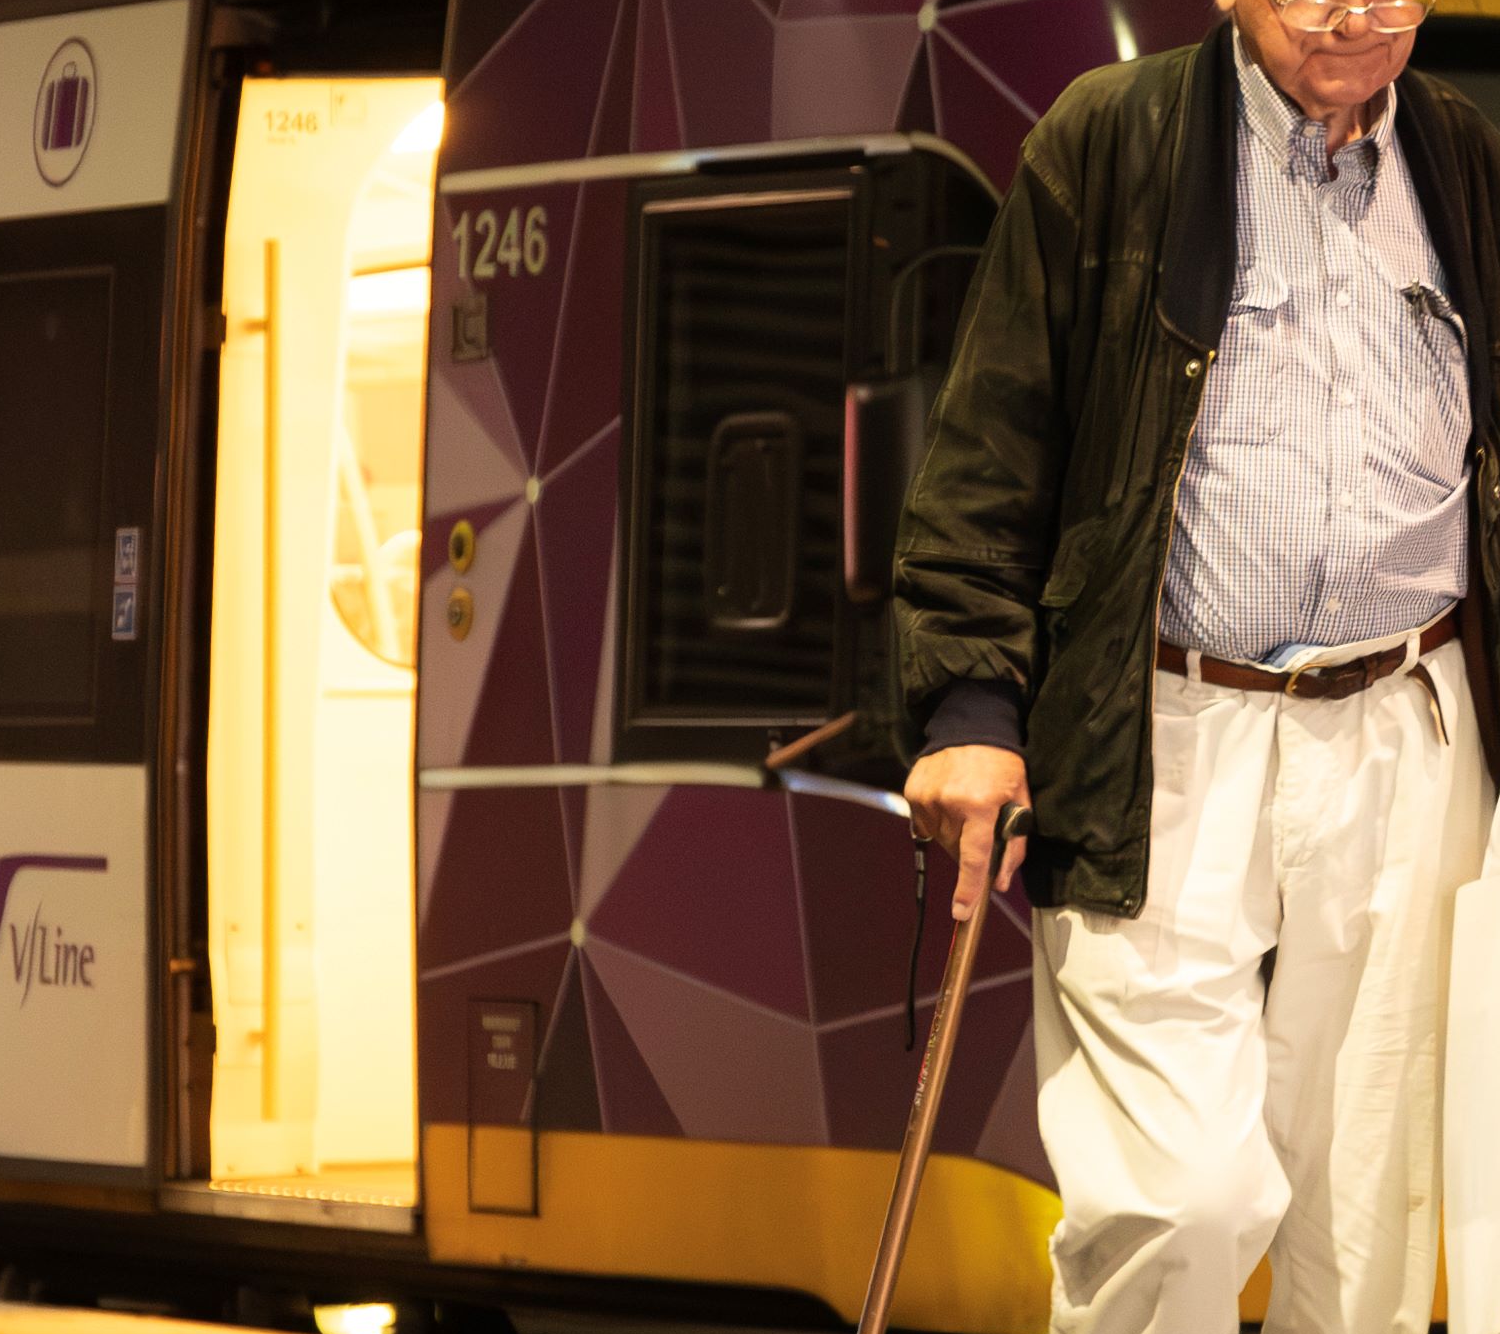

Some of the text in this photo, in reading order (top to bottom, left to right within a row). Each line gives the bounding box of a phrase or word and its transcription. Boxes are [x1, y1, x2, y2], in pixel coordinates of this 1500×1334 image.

[264, 110, 318, 133] 1246
[452, 206, 547, 279] 1246
[9, 900, 96, 1009] V/Line
